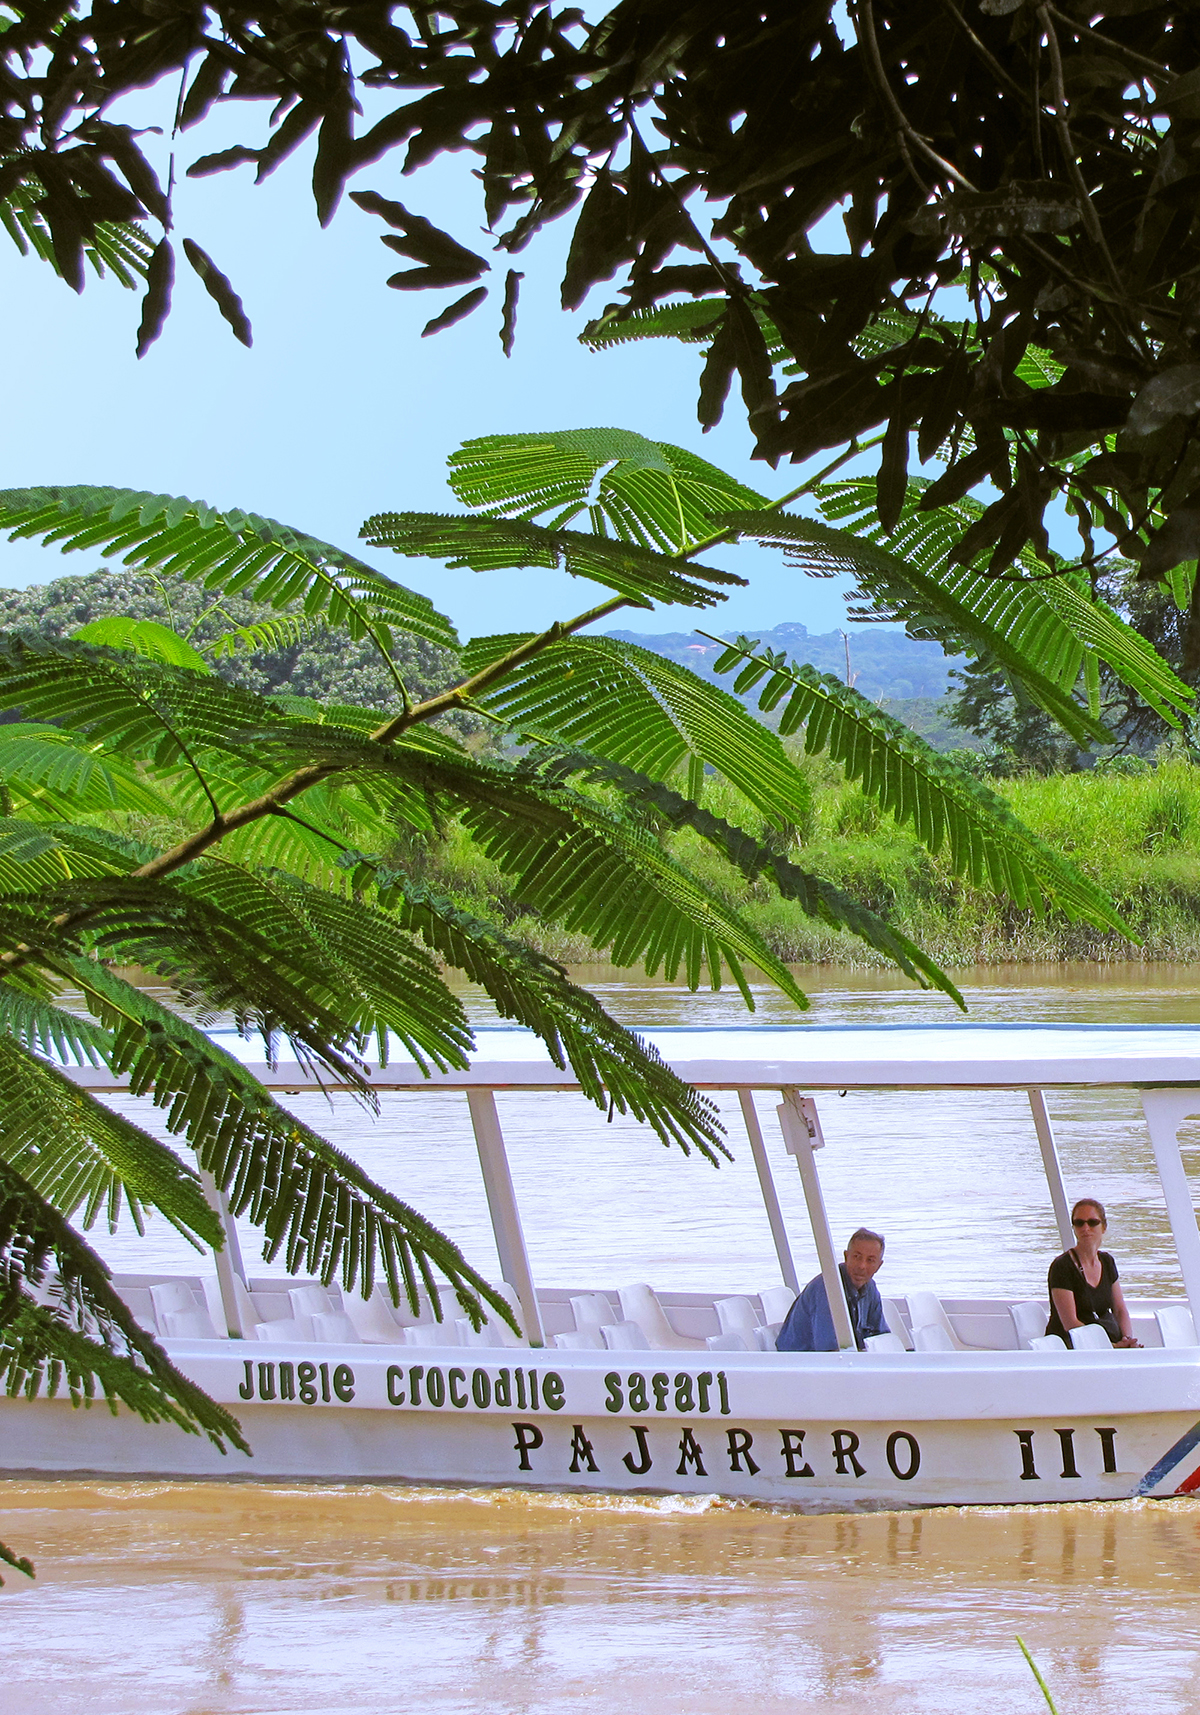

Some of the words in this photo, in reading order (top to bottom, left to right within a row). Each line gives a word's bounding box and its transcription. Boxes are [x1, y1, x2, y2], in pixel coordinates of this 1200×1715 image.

[238, 1359, 356, 1406] Jungle
[511, 1422, 921, 1482] PAJARERO
[1013, 1427, 1119, 1482] III
